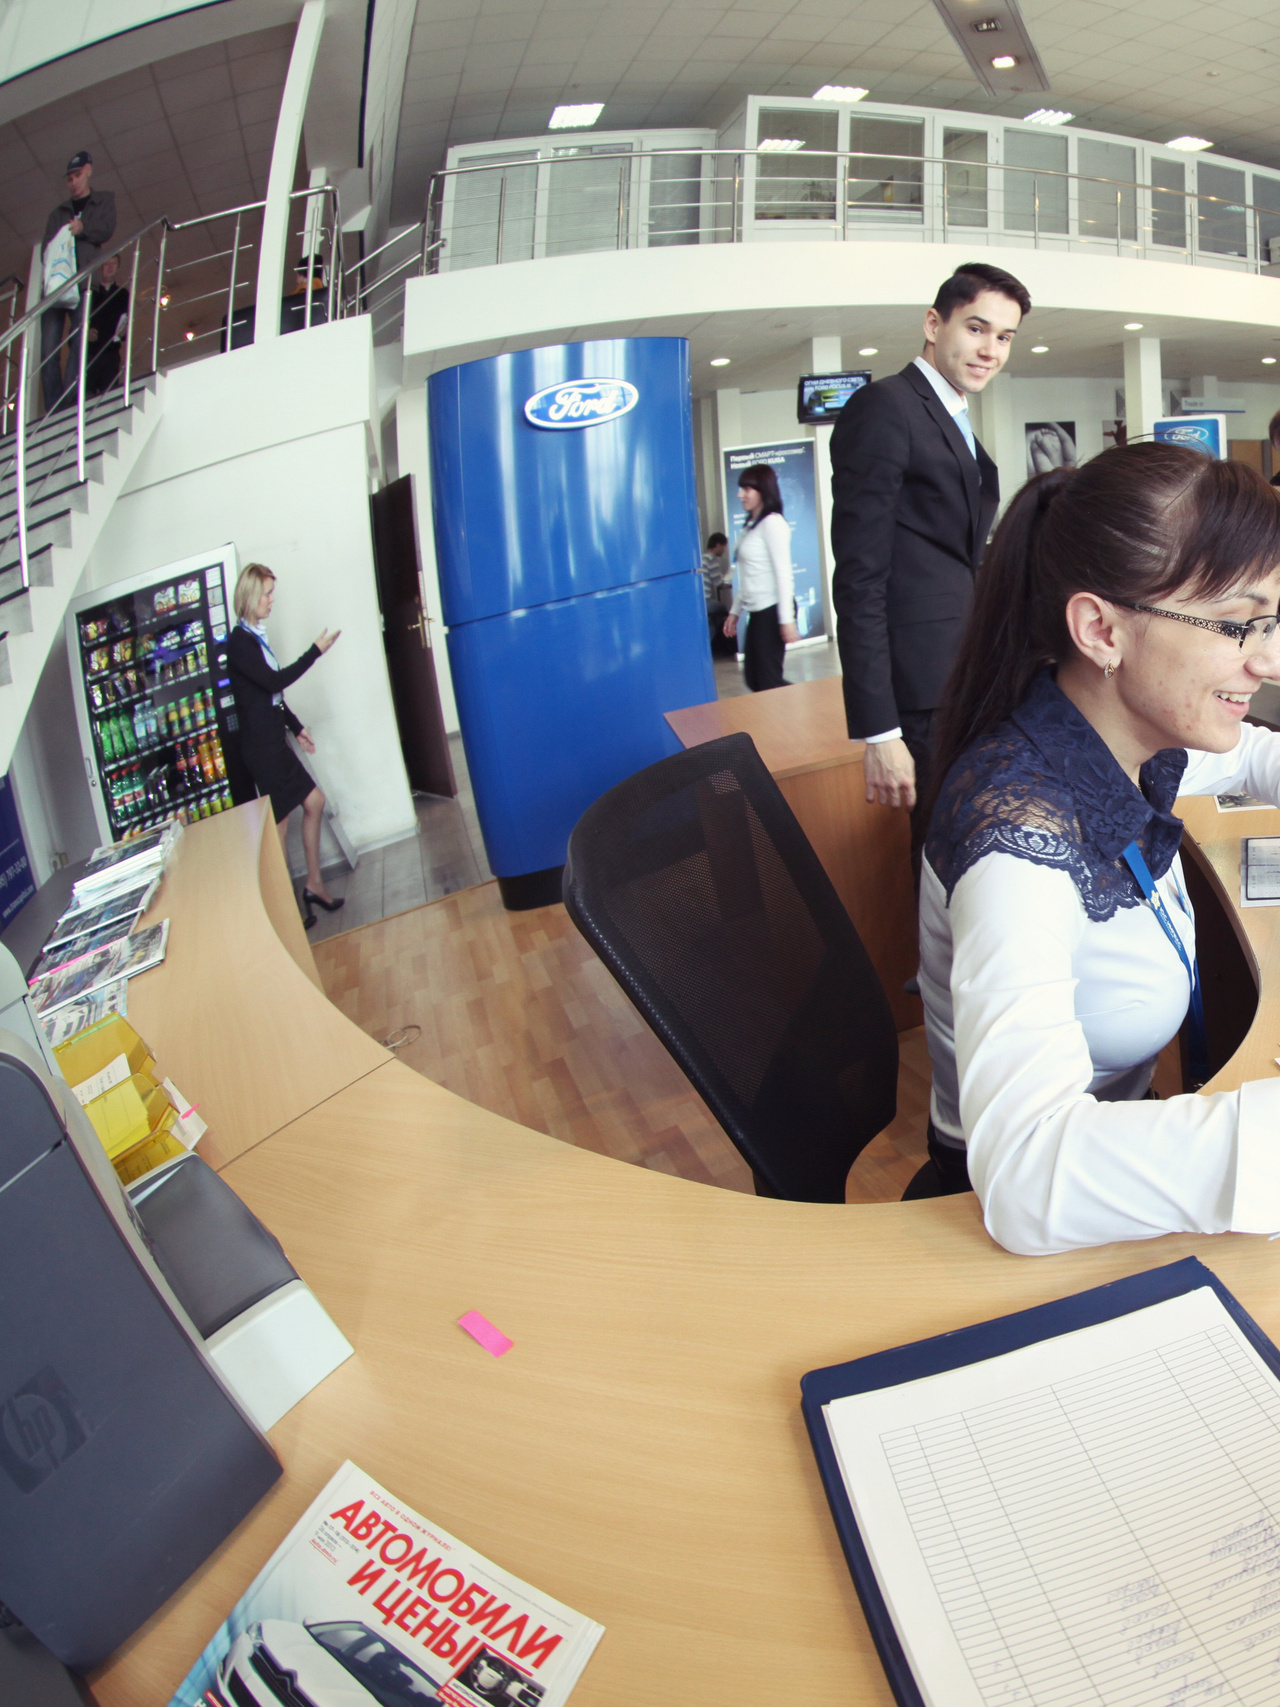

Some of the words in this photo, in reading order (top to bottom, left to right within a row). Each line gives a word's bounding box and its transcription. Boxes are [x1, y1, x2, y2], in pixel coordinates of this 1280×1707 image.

[329, 1499, 563, 1669] АВТОМОБИЛИ
[347, 1558, 387, 1597] И
[372, 1579, 480, 1668] ЦЕНЫ
